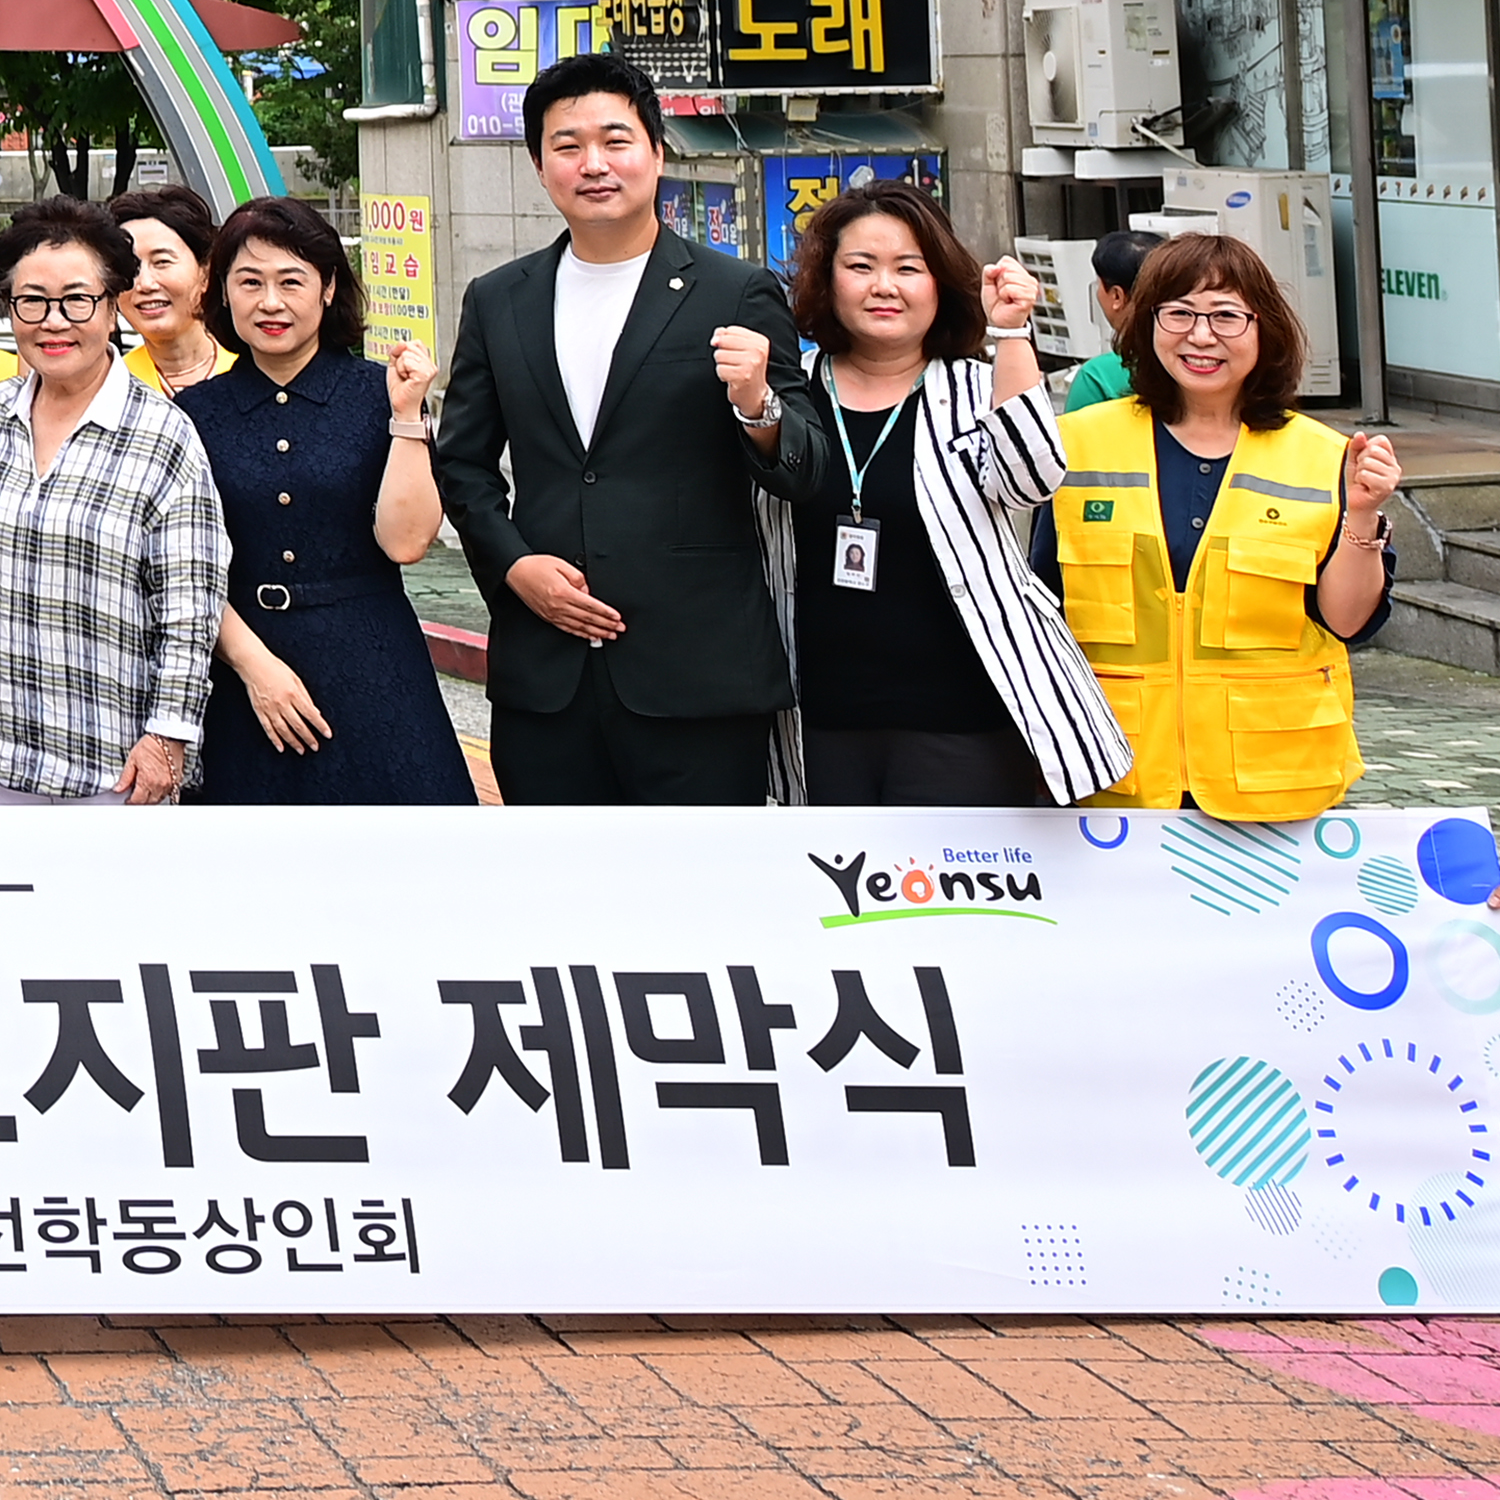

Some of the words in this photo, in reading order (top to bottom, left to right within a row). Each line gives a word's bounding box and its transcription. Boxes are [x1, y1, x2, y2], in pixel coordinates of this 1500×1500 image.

[468, 115, 524, 135] 010-5
[363, 252, 419, 278] 임교습
[943, 848, 998, 863] Better
[1004, 847, 1032, 863] life
[807, 851, 1042, 917] Yeonsu
[437, 965, 976, 1170] 제막식
